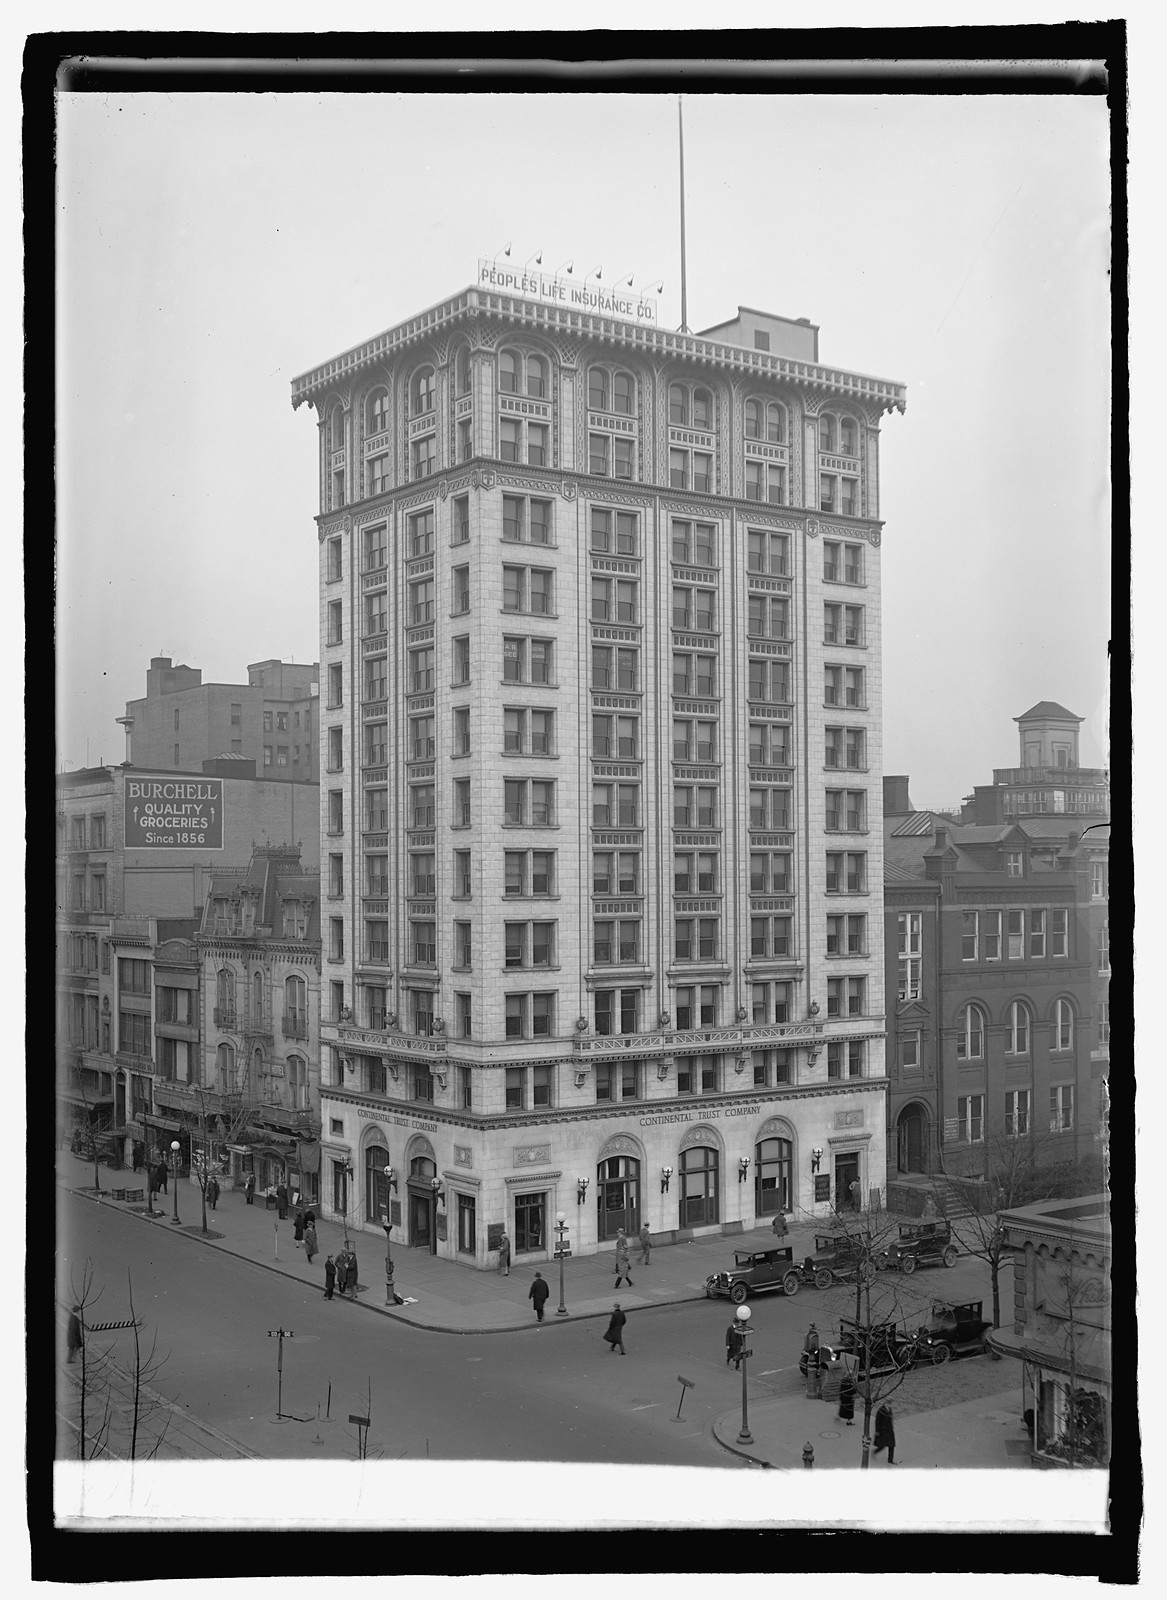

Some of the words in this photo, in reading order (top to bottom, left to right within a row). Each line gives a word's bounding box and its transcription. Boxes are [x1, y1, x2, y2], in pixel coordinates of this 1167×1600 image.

[481, 268, 538, 294] PEOPLES
[541, 282, 566, 301] LIFE
[571, 289, 633, 315] INSURANCE
[637, 304, 655, 320] CO.
[128, 782, 218, 800] BURCHELL
[144, 803, 203, 816] QUALITY
[139, 816, 208, 829] GROCERIES
[145, 832, 174, 843] Since
[176, 832, 205, 844] 1856
[357, 1108, 391, 1123] CONTINENTAL
[394, 1116, 409, 1127] TRUST
[412, 1120, 438, 1133] COMPANY
[639, 1113, 693, 1127] CONTINENTAL
[697, 1110, 721, 1120] TRUST
[725, 1106, 762, 1118] COMPANY
